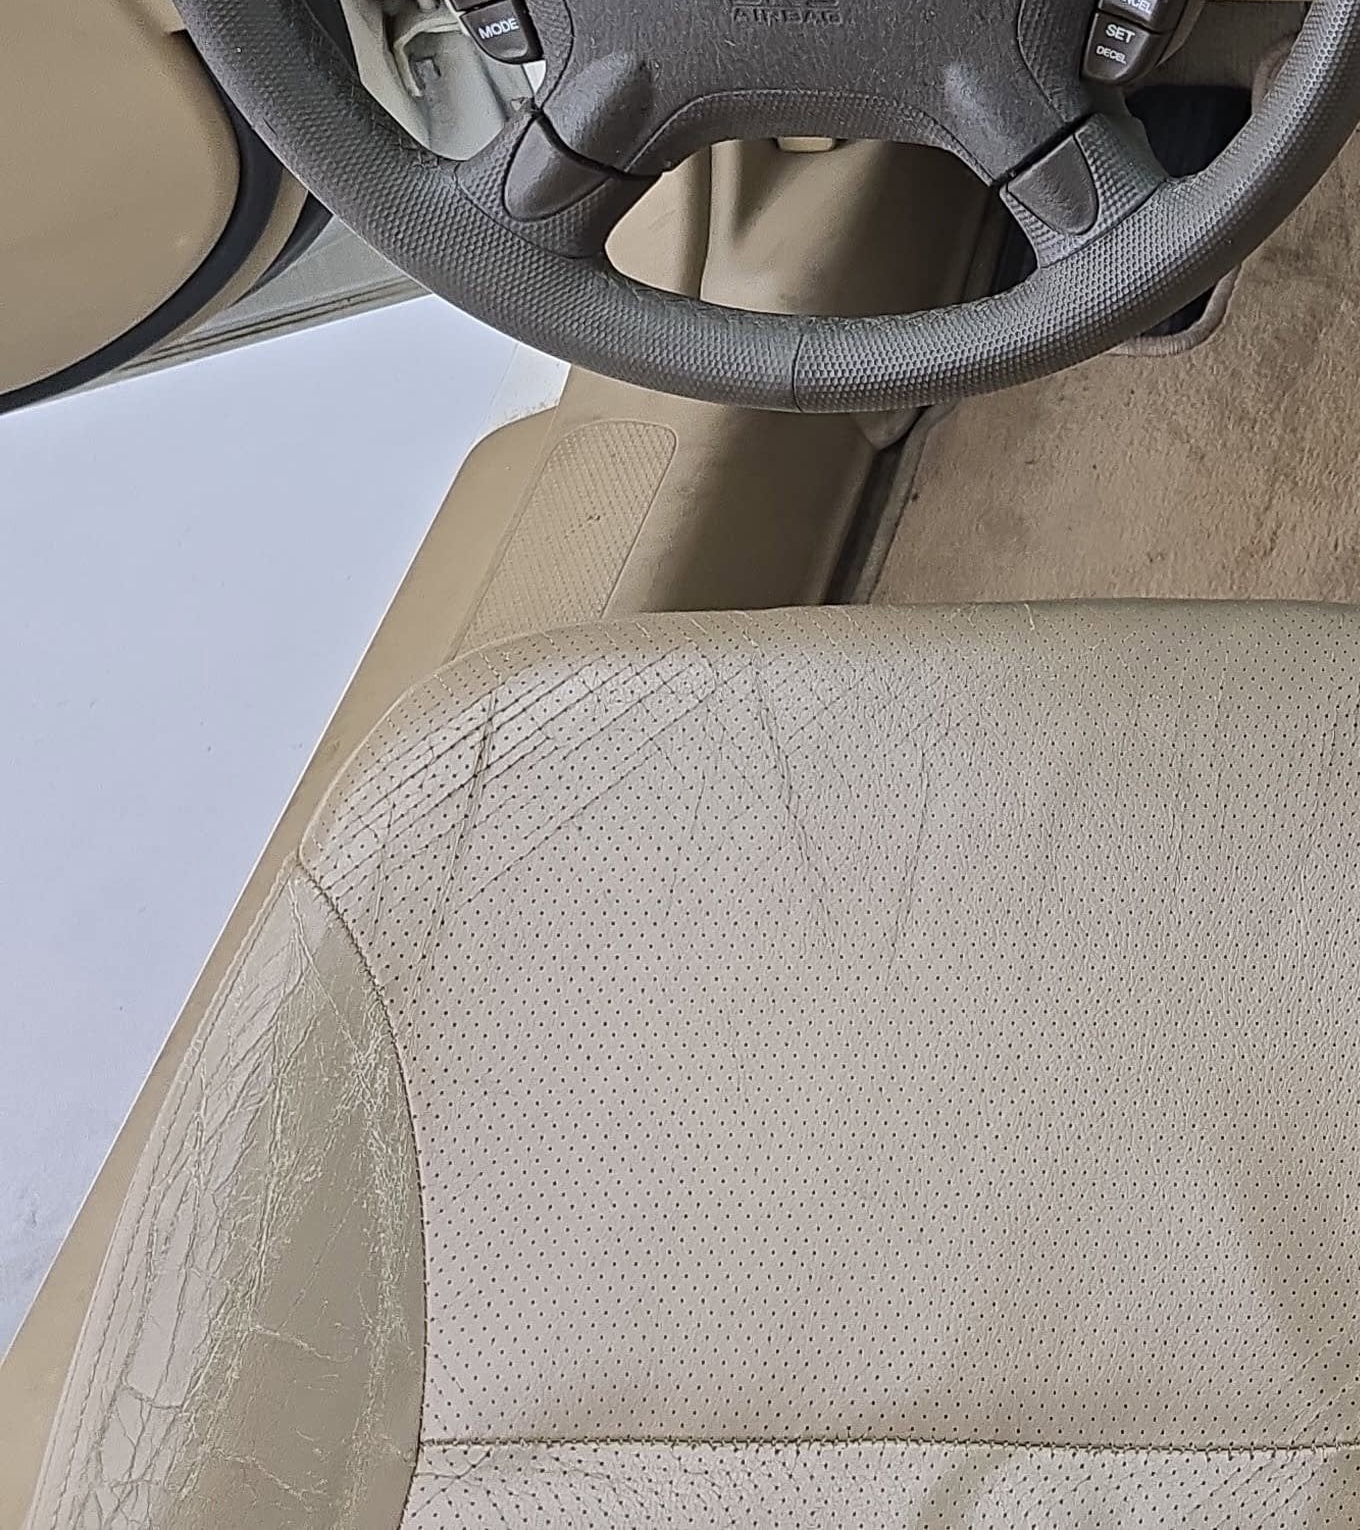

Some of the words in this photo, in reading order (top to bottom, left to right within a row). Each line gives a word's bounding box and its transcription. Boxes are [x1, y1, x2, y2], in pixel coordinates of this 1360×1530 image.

[479, 18, 519, 41] MODE
[1105, 24, 1136, 44] SET
[1096, 45, 1128, 65] DECEL
